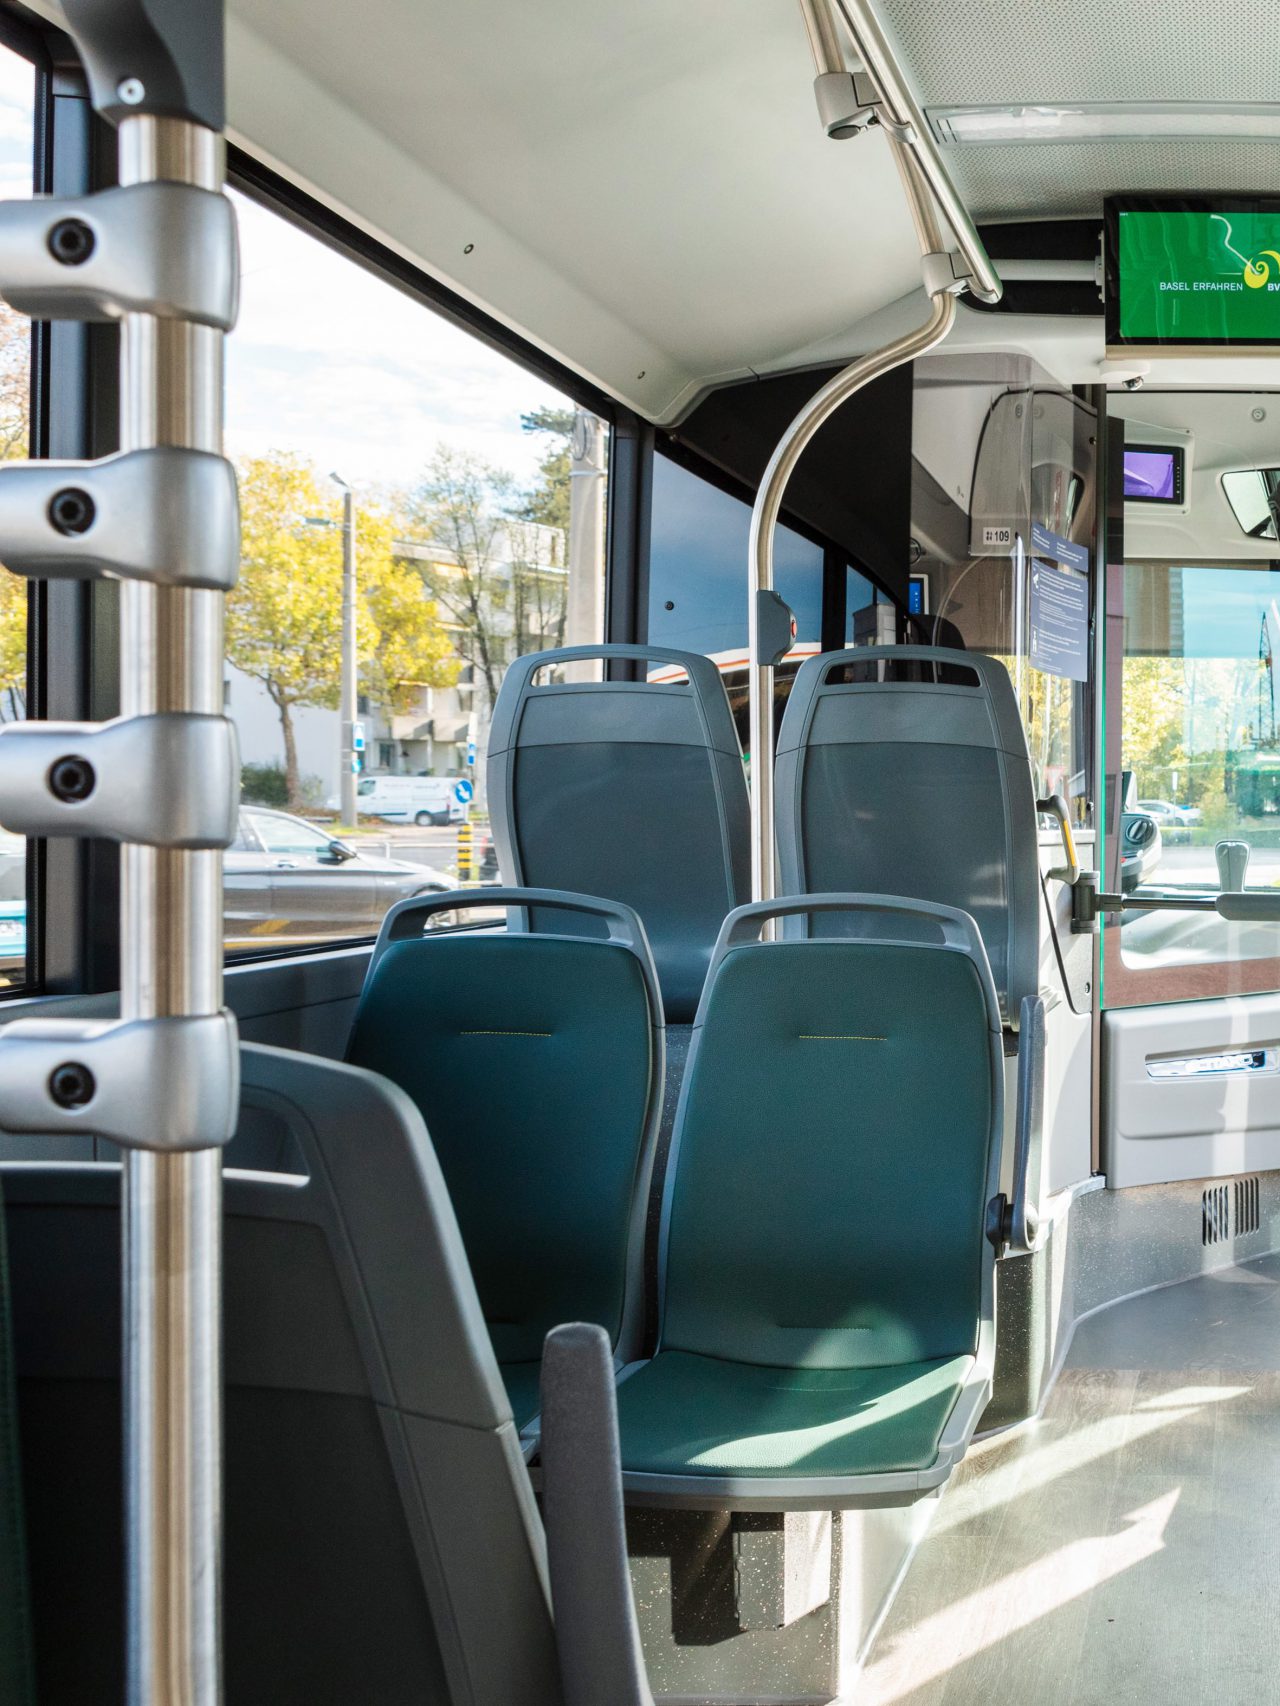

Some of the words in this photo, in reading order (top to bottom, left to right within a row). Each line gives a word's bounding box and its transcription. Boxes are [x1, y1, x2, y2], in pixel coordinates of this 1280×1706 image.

[1159, 282, 1190, 291] BASEL
[1193, 282, 1243, 291] ERFAHREN
[994, 530, 1010, 542] 109
